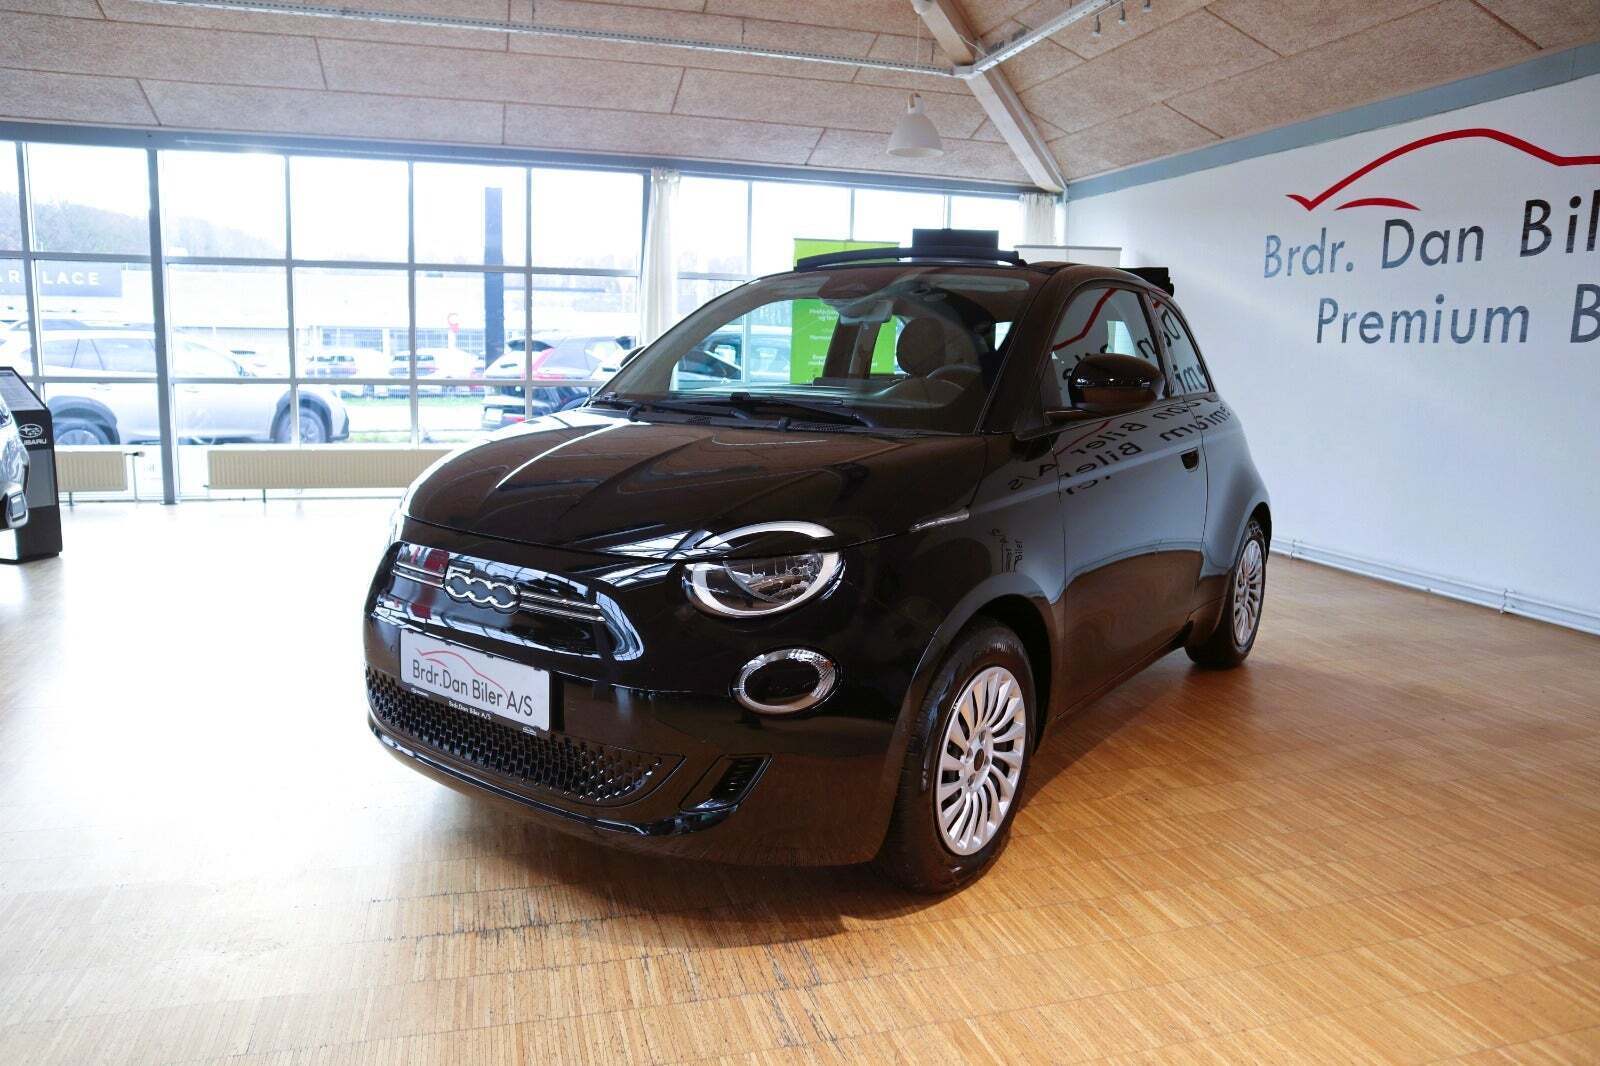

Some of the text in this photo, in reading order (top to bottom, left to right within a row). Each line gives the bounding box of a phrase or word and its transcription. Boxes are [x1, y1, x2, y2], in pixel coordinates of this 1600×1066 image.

[1264, 227, 1354, 278] Brdr.
[1382, 218, 1485, 269] Dan
[1316, 293, 1530, 344] Premium
[445, 566, 518, 609] 500
[472, 679, 503, 707] Biler
[506, 691, 533, 717] A/S
